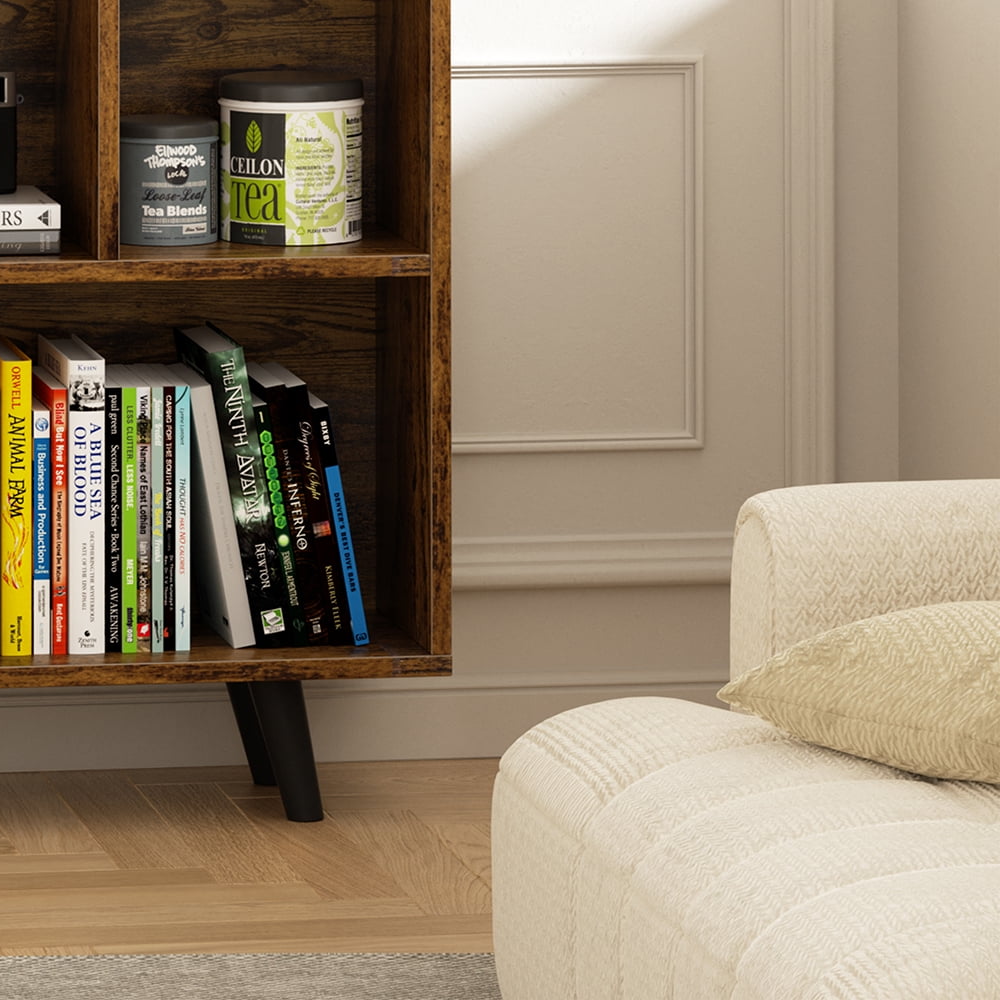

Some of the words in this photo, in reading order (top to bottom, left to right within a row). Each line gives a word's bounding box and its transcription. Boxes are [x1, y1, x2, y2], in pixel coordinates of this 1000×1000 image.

[230, 156, 284, 176] CEILON
[142, 187, 208, 204] Loose-Leaf
[142, 204, 164, 217] Tea
[166, 204, 208, 217] Blends
[220, 358, 236, 386] THE
[11, 366, 22, 410] ORWELL
[55, 402, 64, 425] Blind
[110, 394, 120, 411] paul
[126, 406, 134, 424] LESS
[139, 394, 148, 420] Viking
[224, 384, 248, 446] NINTH
[56, 426, 64, 442] But
[90, 422, 102, 435] A
[109, 413, 117, 434] green
[140, 422, 148, 444] Place
[320, 420, 331, 446] BIXBY
[8, 413, 26, 474] ANIMAL
[74, 426, 86, 450] OF
[126, 426, 134, 462] CLUTTER.
[56, 444, 64, 462] Now
[90, 440, 102, 486] BLUE
[110, 444, 119, 472] Second
[140, 446, 148, 472] Names
[38, 452, 46, 492] Business
[56, 470, 64, 486] See
[126, 464, 134, 482] LESS
[140, 474, 148, 484] of
[8, 478, 28, 518] FARM
[74, 454, 86, 518] BLOOD
[110, 474, 119, 502] Chance
[126, 485, 134, 511] NOISE.
[140, 486, 148, 503] East
[236, 454, 260, 524] AVATAR
[38, 493, 46, 510] and
[90, 489, 102, 520] SEA
[334, 492, 345, 530] DENVER'S
[110, 504, 119, 527] Series
[140, 505, 148, 534] Lothian
[288, 483, 308, 550] INFERNO
[38, 513, 46, 564] Production
[110, 534, 119, 553] Book
[140, 541, 148, 554] Iain
[180, 532, 186, 544] NO
[340, 532, 350, 550] BEST
[110, 554, 119, 572] Two
[126, 558, 134, 584] MEYER
[254, 542, 271, 591] NEWTON
[344, 552, 352, 571] DIVE
[140, 576, 148, 613] Johnstone
[325, 564, 338, 605] KIMBERLY
[348, 572, 356, 592] BARS
[110, 586, 118, 644] AWAKENING
